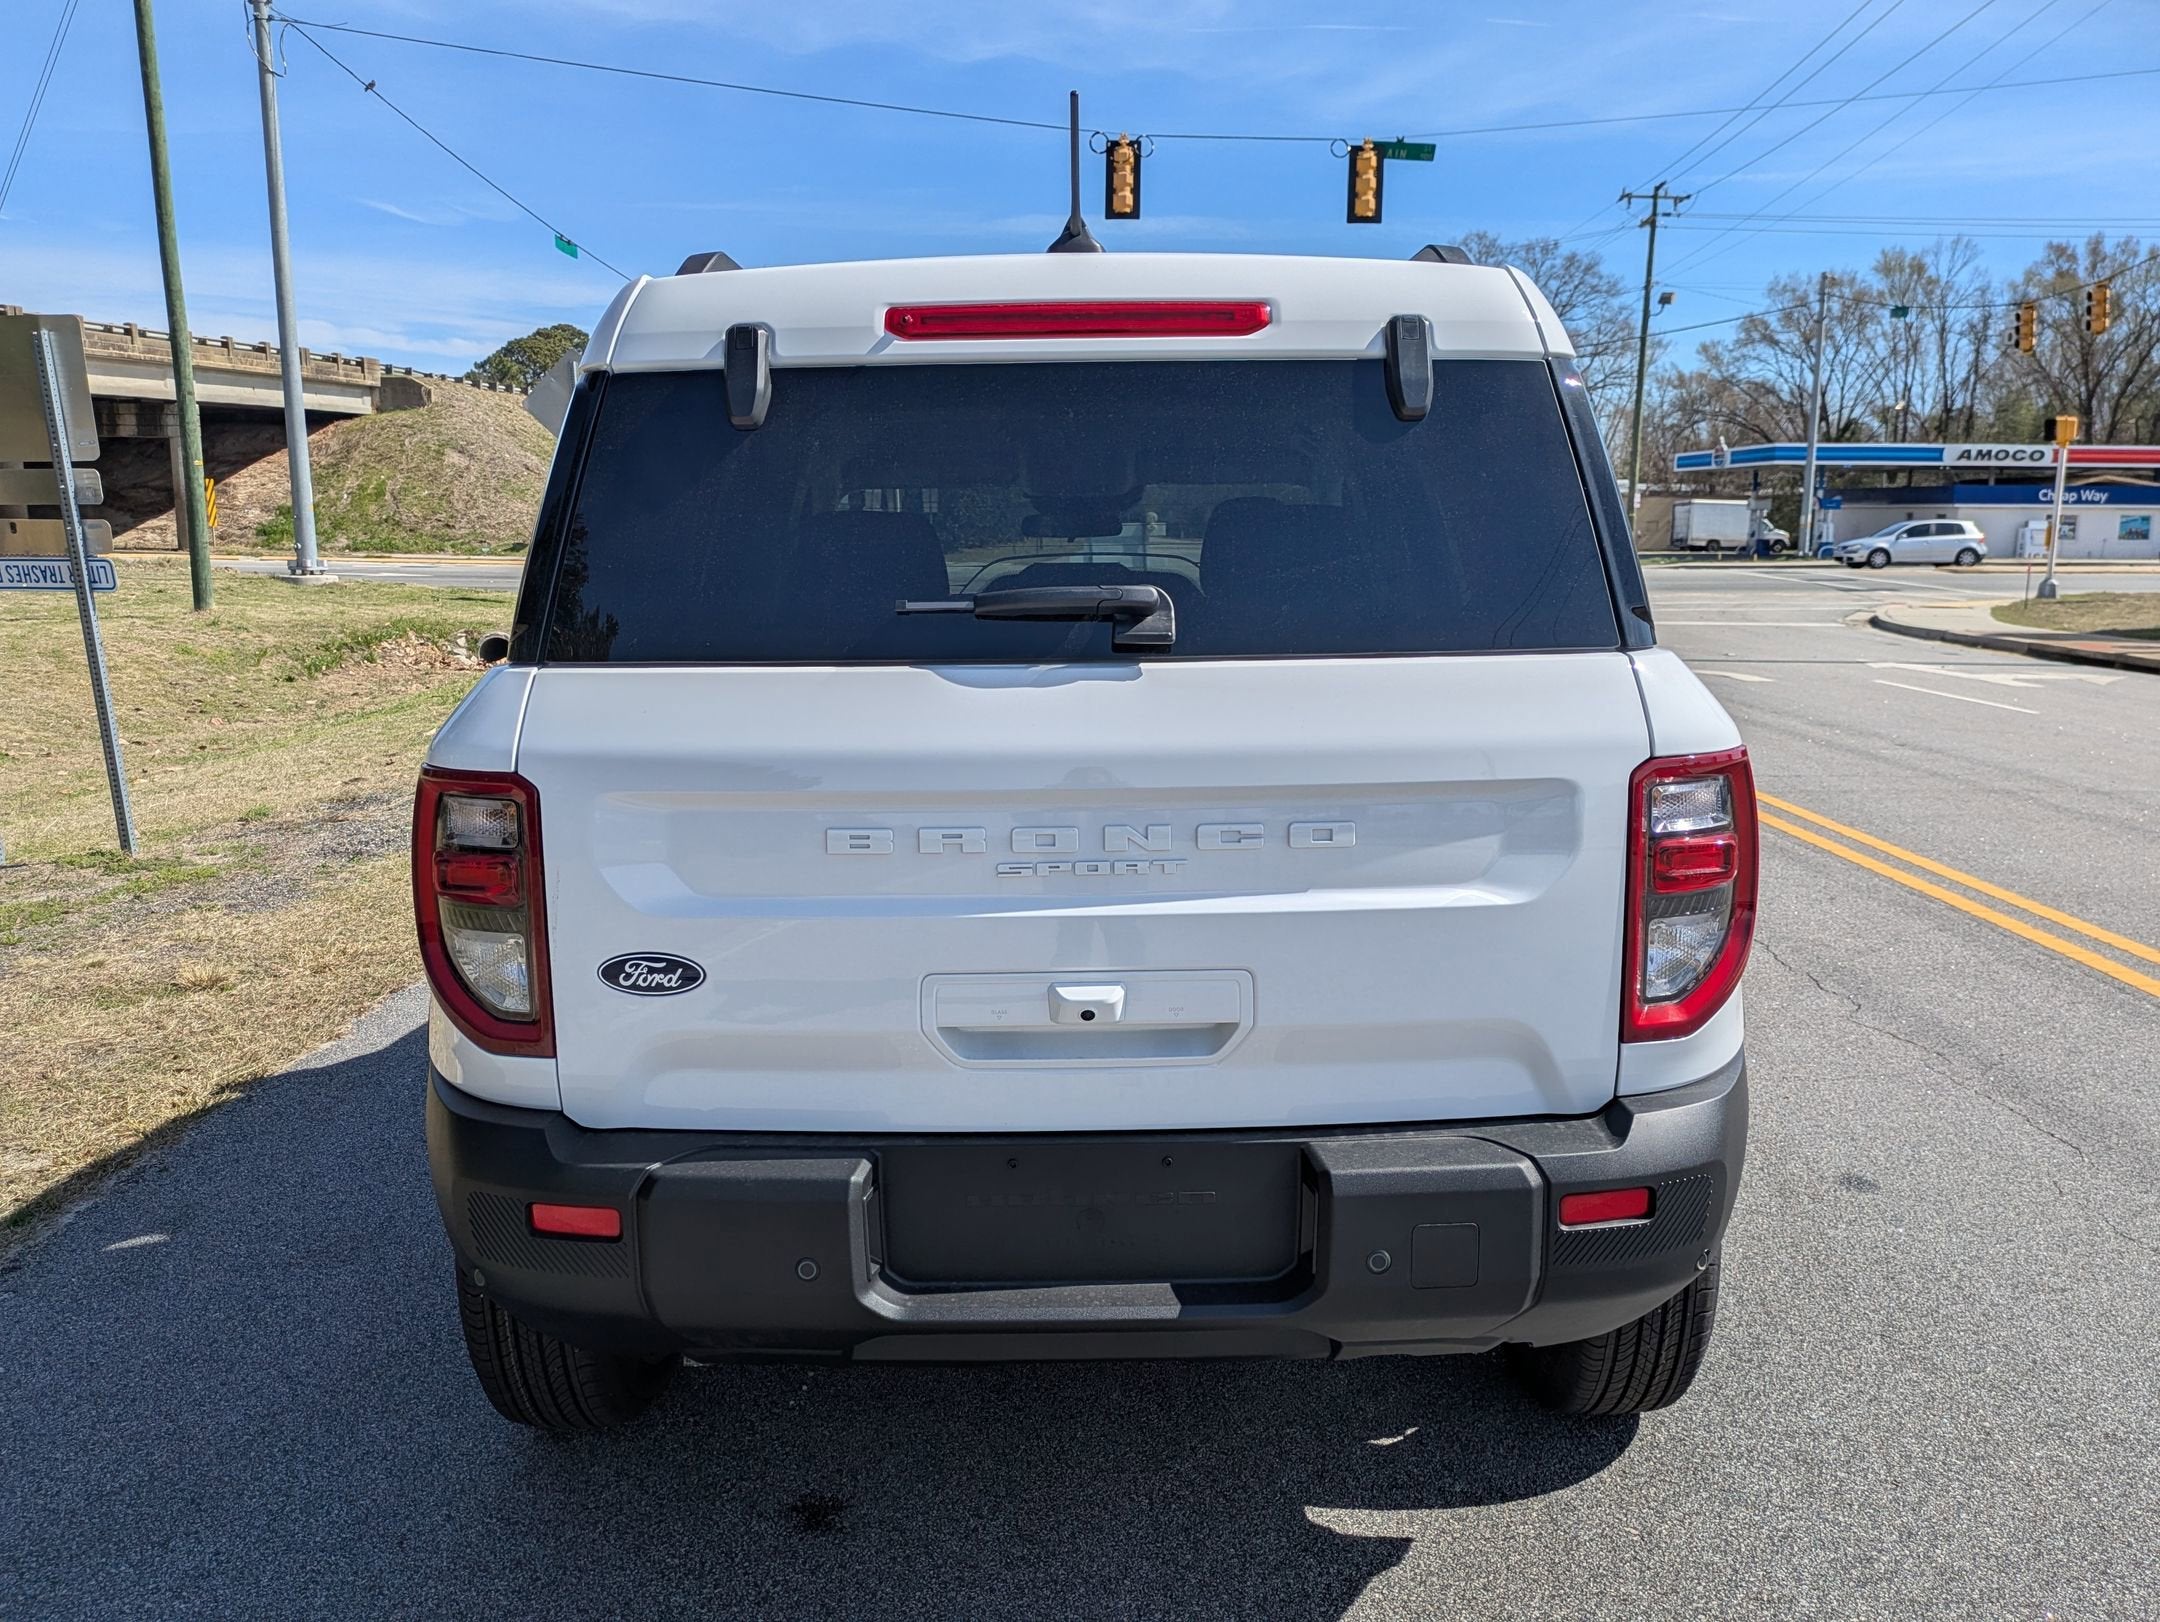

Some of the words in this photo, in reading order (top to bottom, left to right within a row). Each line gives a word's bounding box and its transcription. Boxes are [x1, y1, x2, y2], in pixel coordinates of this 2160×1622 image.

[1956, 449, 2046, 462] AMOCO
[2038, 489, 2078, 503] Chap
[2080, 489, 2109, 503] Way
[5, 565, 66, 584] TRASHES
[67, 565, 109, 584] LITR
[825, 820, 1357, 855] BRONCO
[996, 858, 1189, 878] SPORT
[619, 960, 683, 988] Ford
